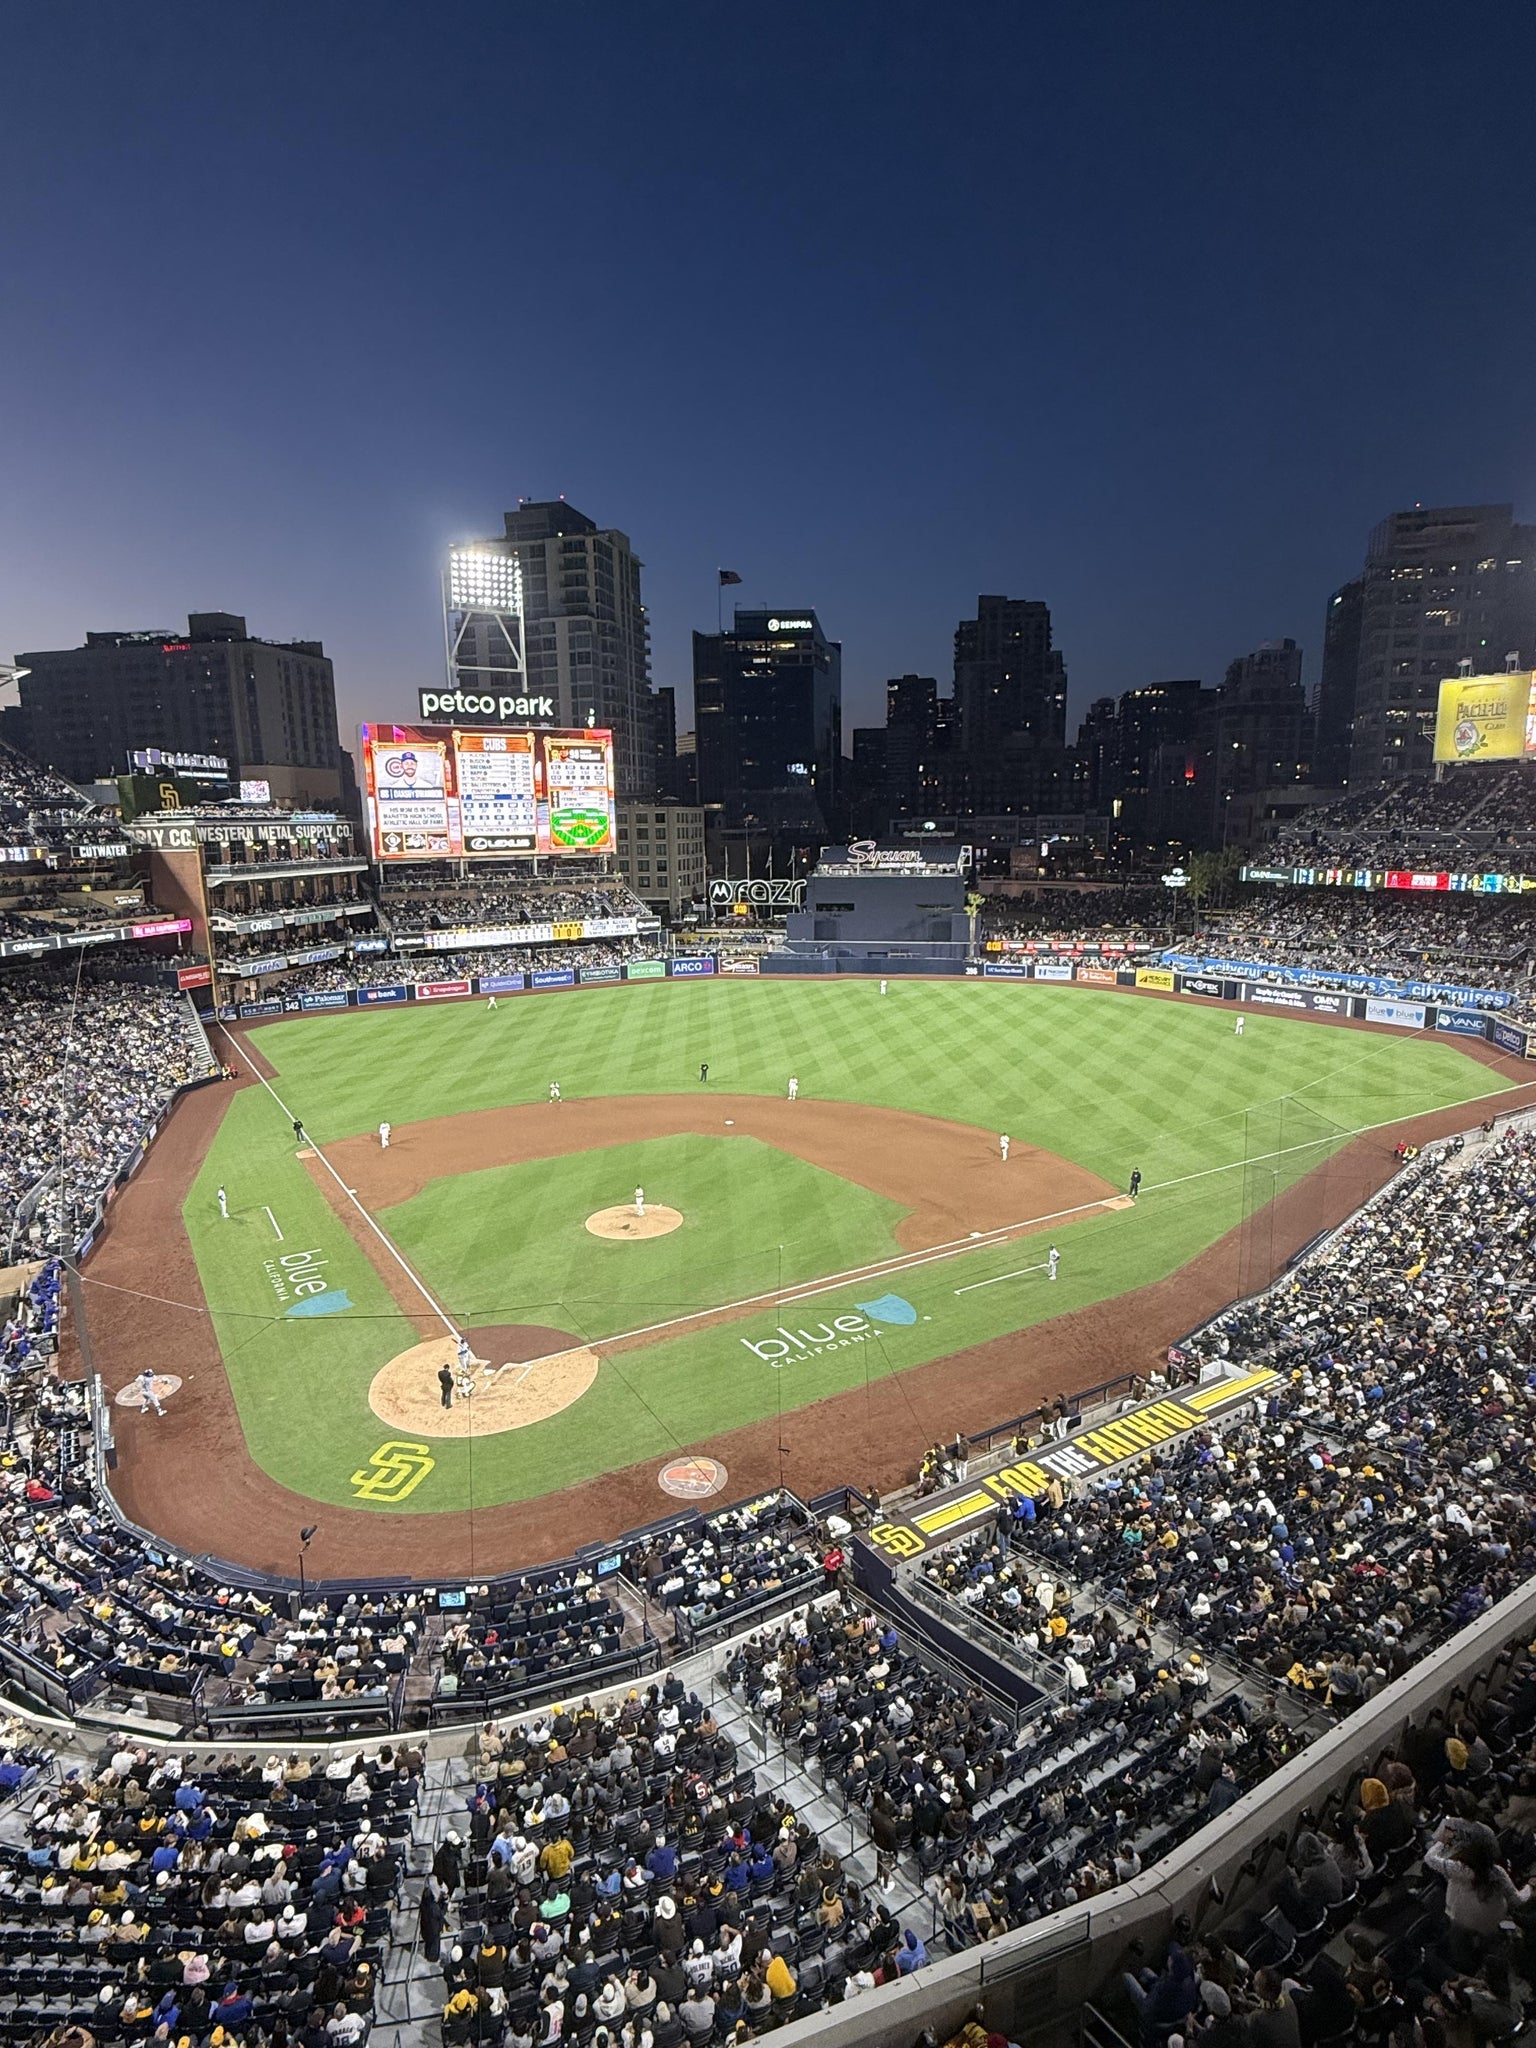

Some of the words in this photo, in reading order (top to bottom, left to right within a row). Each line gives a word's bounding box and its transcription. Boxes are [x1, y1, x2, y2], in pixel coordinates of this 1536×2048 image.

[780, 621, 813, 629] SEMPRA
[422, 690, 496, 717] petco
[499, 696, 554, 720] park
[483, 738, 507, 751] CUBS
[169, 829, 196, 846] CO.
[197, 827, 254, 842] WESTERN
[258, 826, 294, 840] METAL
[296, 825, 333, 839] SUPPLY
[336, 825, 351, 837] CO.
[80, 845, 127, 857] CUTWATER
[847, 840, 923, 868] Sycuan
[734, 879, 807, 903] razr
[674, 963, 702, 972] ARCO
[535, 975, 567, 984] Southwest
[377, 989, 397, 998] bank
[432, 985, 465, 993] Snapdragon
[314, 994, 344, 1002] Palomar
[1313, 995, 1340, 1006] OMNI
[285, 1001, 299, 1011] 342
[1368, 1005, 1385, 1015] blue
[1396, 1007, 1414, 1018] blue
[279, 1248, 329, 1296] blue
[263, 1259, 290, 1301] CALIFORNIA
[740, 1315, 870, 1361] blue
[770, 1329, 884, 1368] CALIFORNIA
[1037, 1446, 1100, 1477] THE
[1072, 1400, 1208, 1465] FAITHFUL
